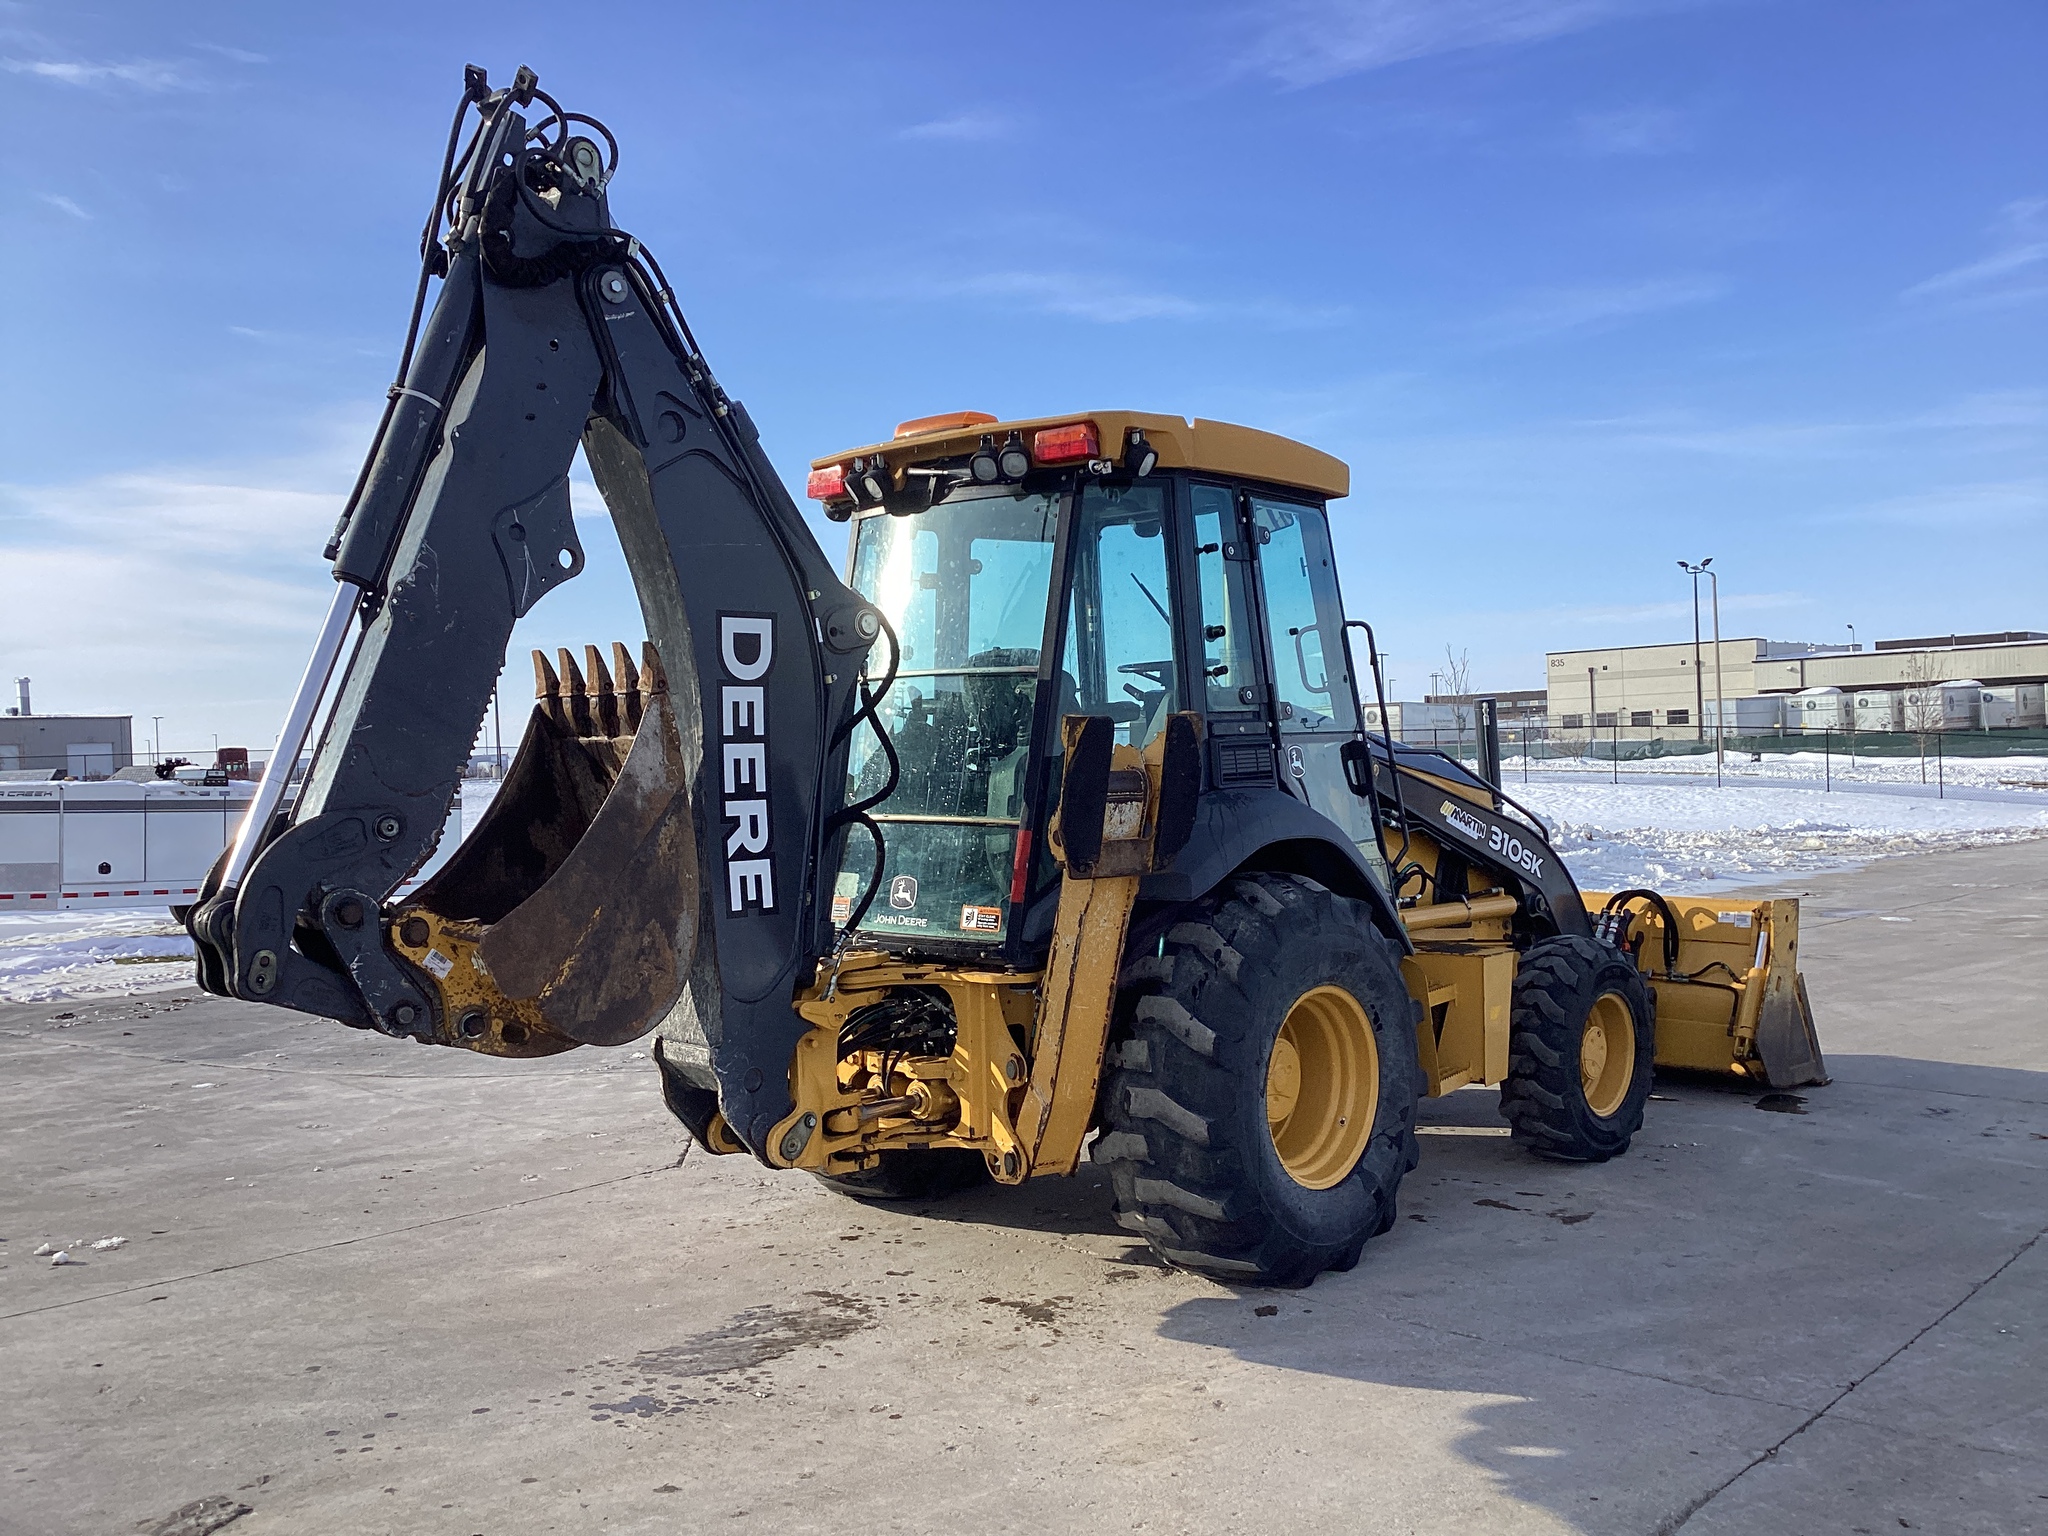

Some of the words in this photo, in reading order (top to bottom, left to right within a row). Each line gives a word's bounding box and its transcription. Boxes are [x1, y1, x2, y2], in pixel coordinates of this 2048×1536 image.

[1550, 659, 1565, 668] 835
[721, 616, 774, 912] DEERE
[1450, 805, 1487, 839] MARTIN
[1488, 825, 1544, 878] 310SK
[874, 913, 897, 925] JOHN
[897, 914, 928, 928] DEERE
